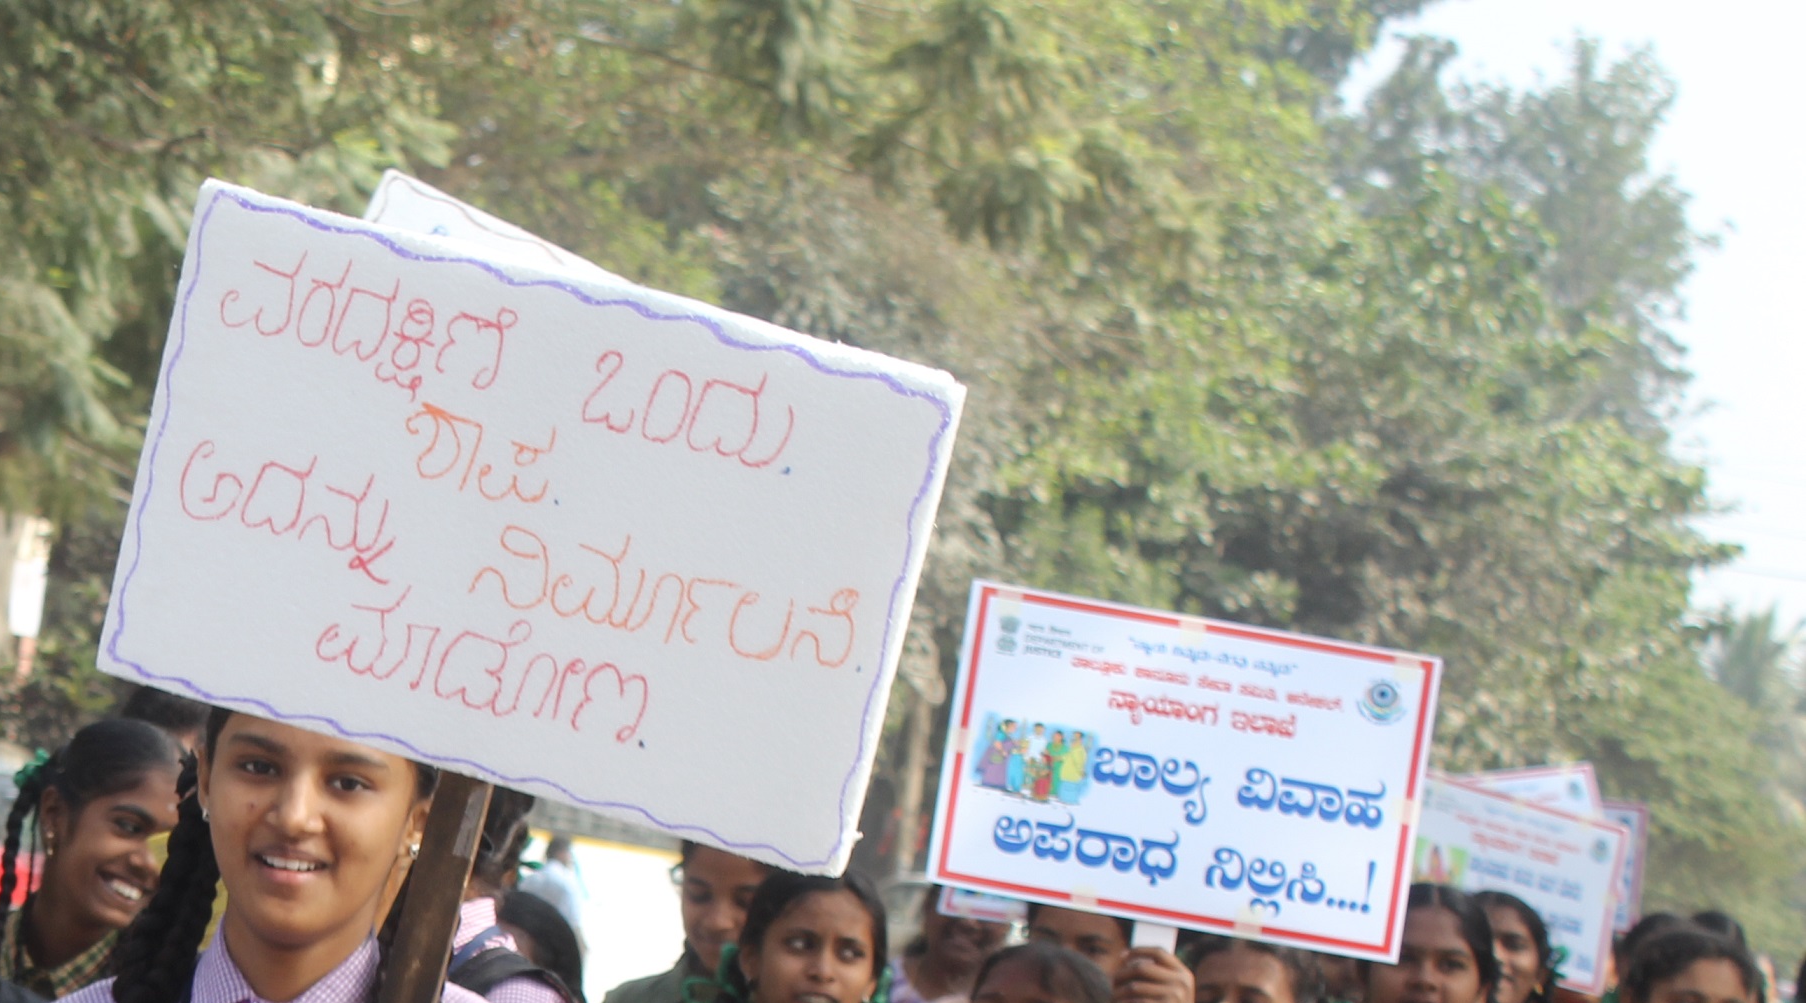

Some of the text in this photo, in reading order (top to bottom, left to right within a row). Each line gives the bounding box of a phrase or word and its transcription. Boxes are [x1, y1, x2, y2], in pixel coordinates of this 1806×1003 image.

[219, 249, 519, 404] ವರದಕ್ಷಿಣೆ
[179, 438, 398, 587] ಅದನ್ನು
[1023, 644, 1062, 658] JUSTICE
[1024, 634, 1089, 652] DEPARTMENT
[1108, 690, 1219, 725] ನ್ಯಾಯಾಂಗ
[1091, 746, 1388, 830] ಬಾಲ್ಯ ವಿವಾಹ
[992, 811, 1180, 887] ಅಪರಾಧ
